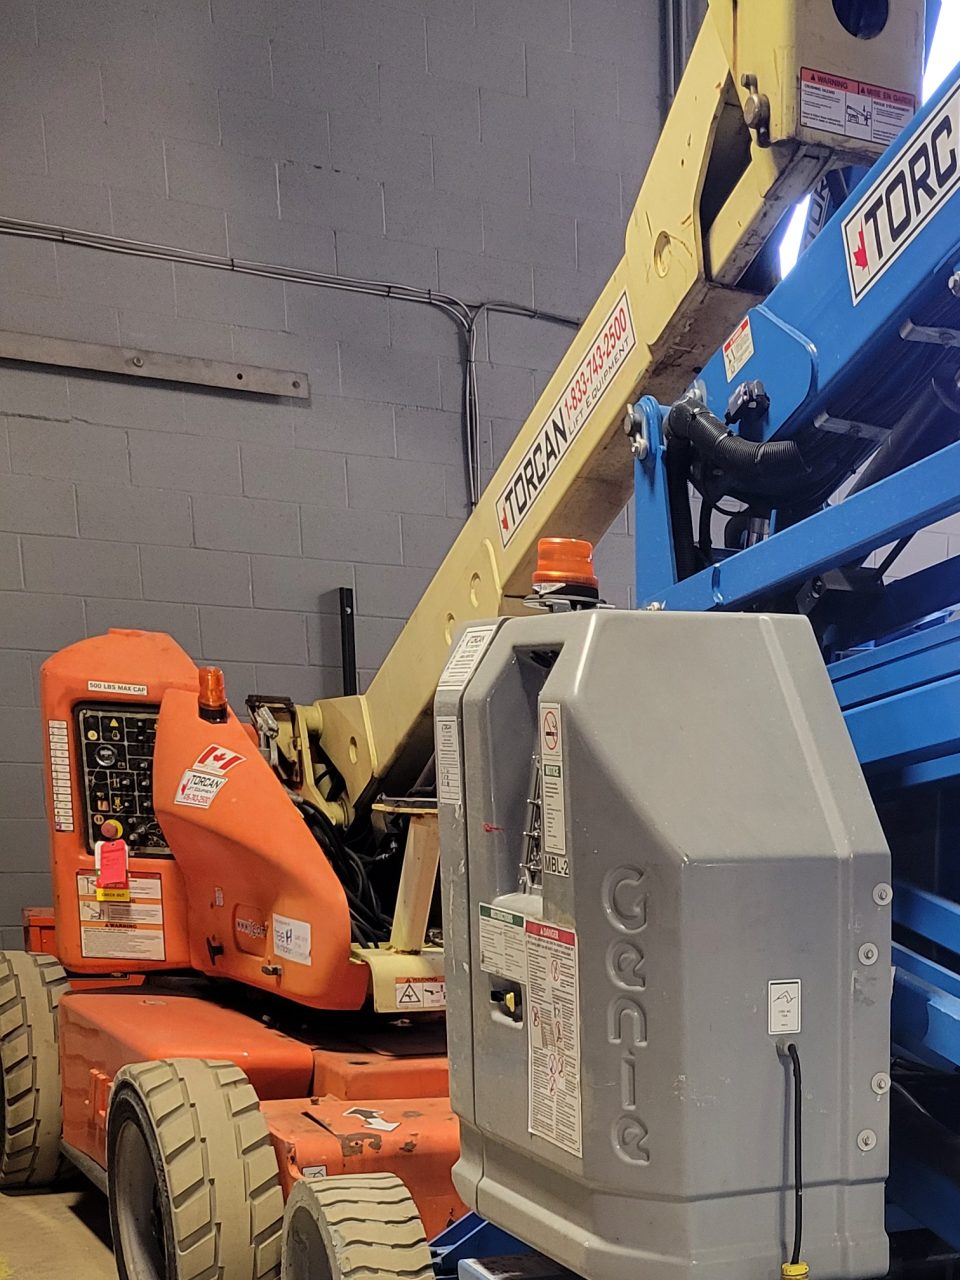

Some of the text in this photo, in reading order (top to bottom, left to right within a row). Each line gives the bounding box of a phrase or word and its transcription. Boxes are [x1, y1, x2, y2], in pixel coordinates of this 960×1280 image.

[504, 307, 627, 526] TORCAN 1-833-743-2500
[568, 335, 630, 435] LIFT EQUIPMENT
[190, 775, 222, 789] TORCAN
[545, 855, 569, 875] MBL-2
[602, 865, 650, 1166] Genie
